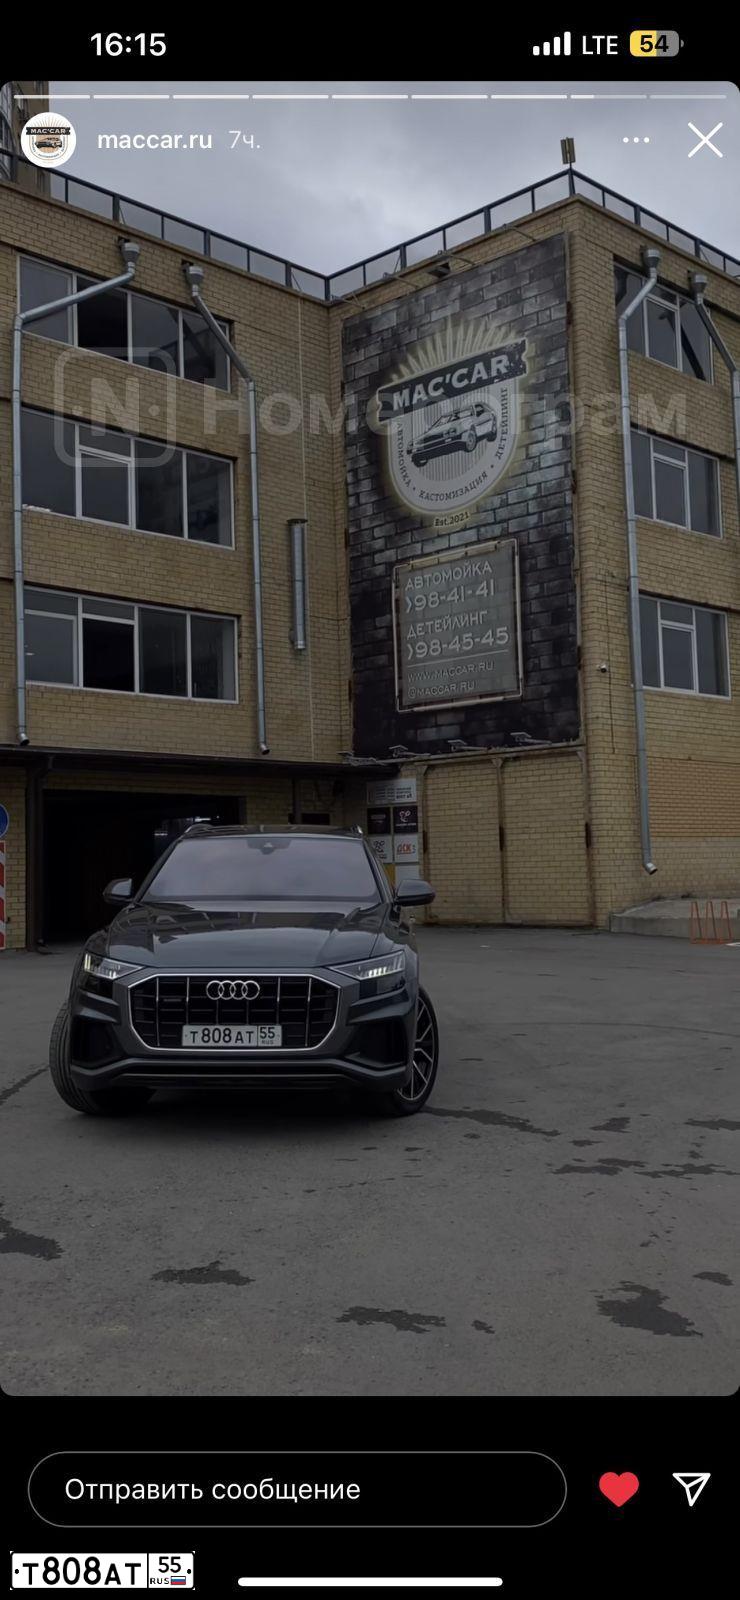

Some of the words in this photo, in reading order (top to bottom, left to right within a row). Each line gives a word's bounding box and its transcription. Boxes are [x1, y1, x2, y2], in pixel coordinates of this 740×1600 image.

[392, 353, 511, 412] MAC'CAR
[418, 471, 489, 501] КАСТОМИЗАЦИЯ
[404, 560, 493, 592] АВТОМОЙКА
[406, 611, 488, 641] ДЕТЕЙЛИНГ
[259, 1026, 275, 1039] 55
